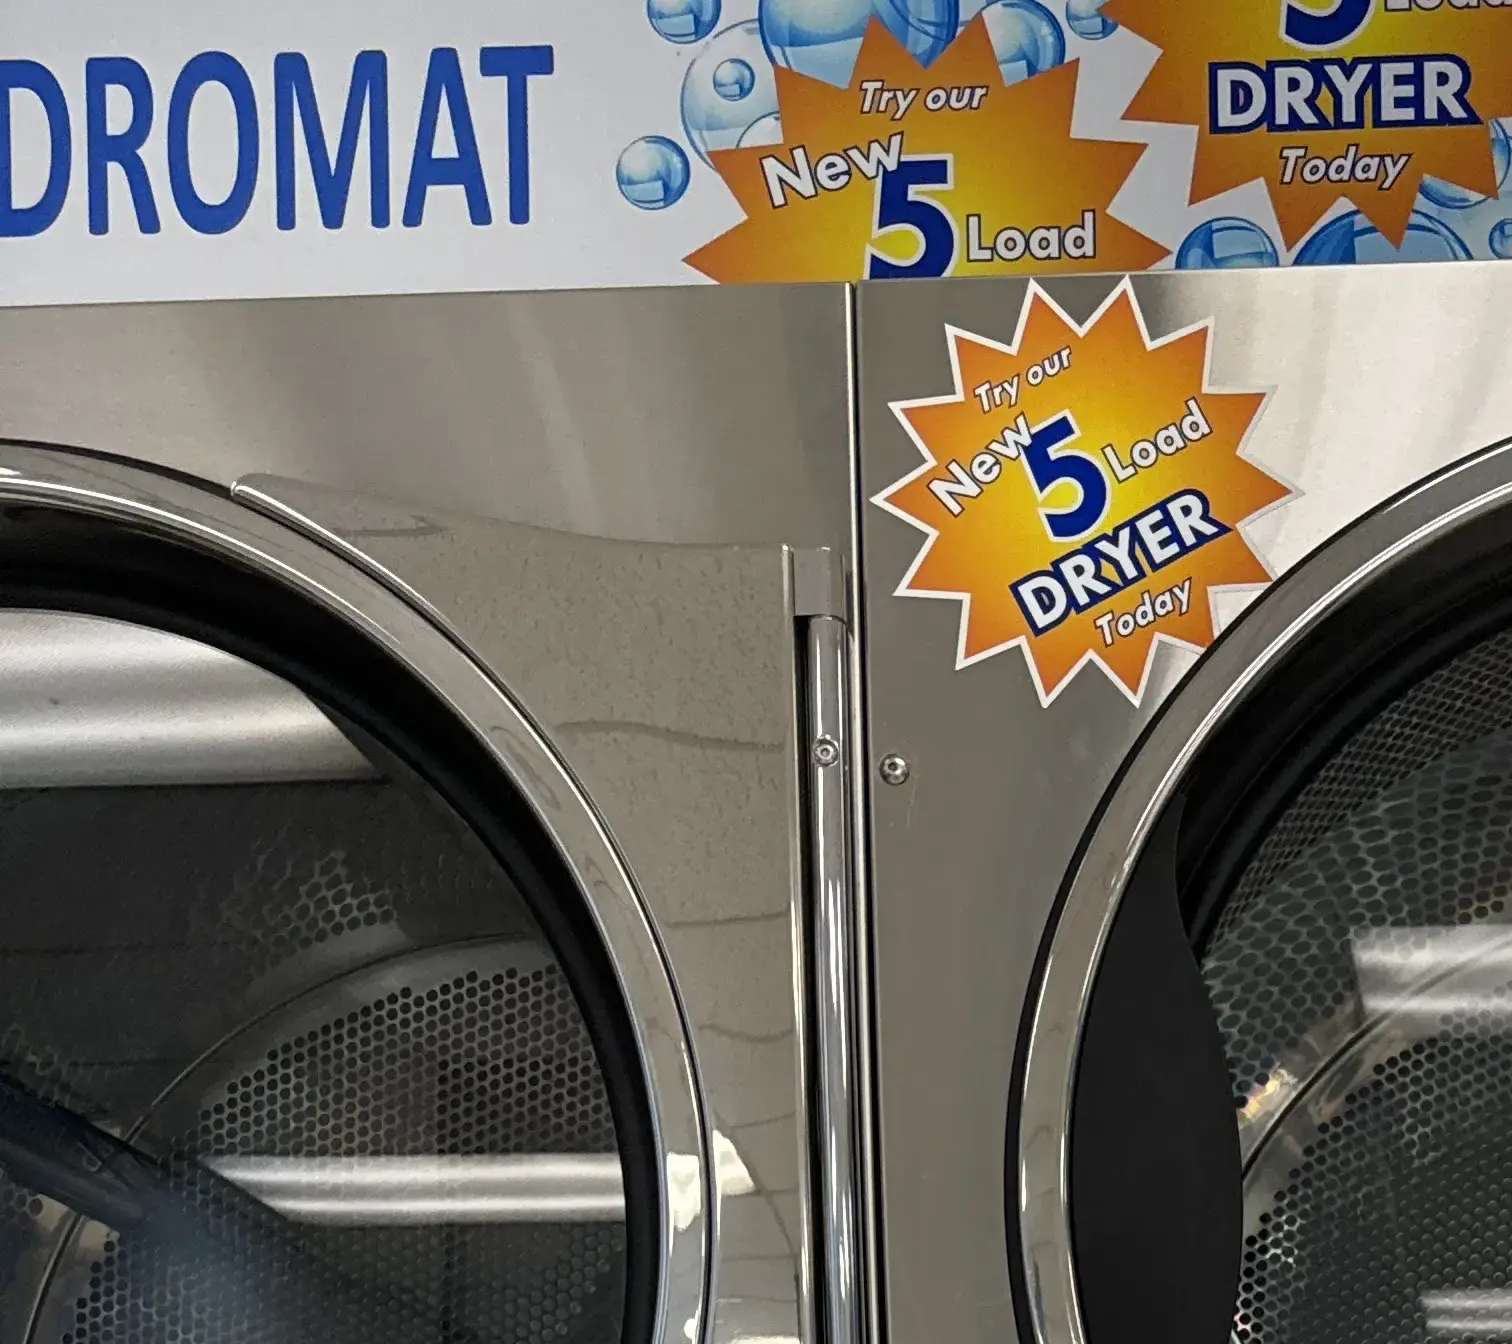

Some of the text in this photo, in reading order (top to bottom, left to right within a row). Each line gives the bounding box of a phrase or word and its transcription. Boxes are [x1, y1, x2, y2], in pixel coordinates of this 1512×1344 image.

[860, 81, 989, 120] Try our
[1211, 55, 1479, 133] DRYER
[0, 45, 553, 237] DROMAT
[1279, 144, 1413, 191] Today
[759, 132, 1096, 279] New 5 Load
[974, 345, 1072, 413] Try our
[927, 396, 1214, 543] New 5 Load
[1009, 489, 1230, 636] DRYER
[1095, 577, 1191, 648] Today
